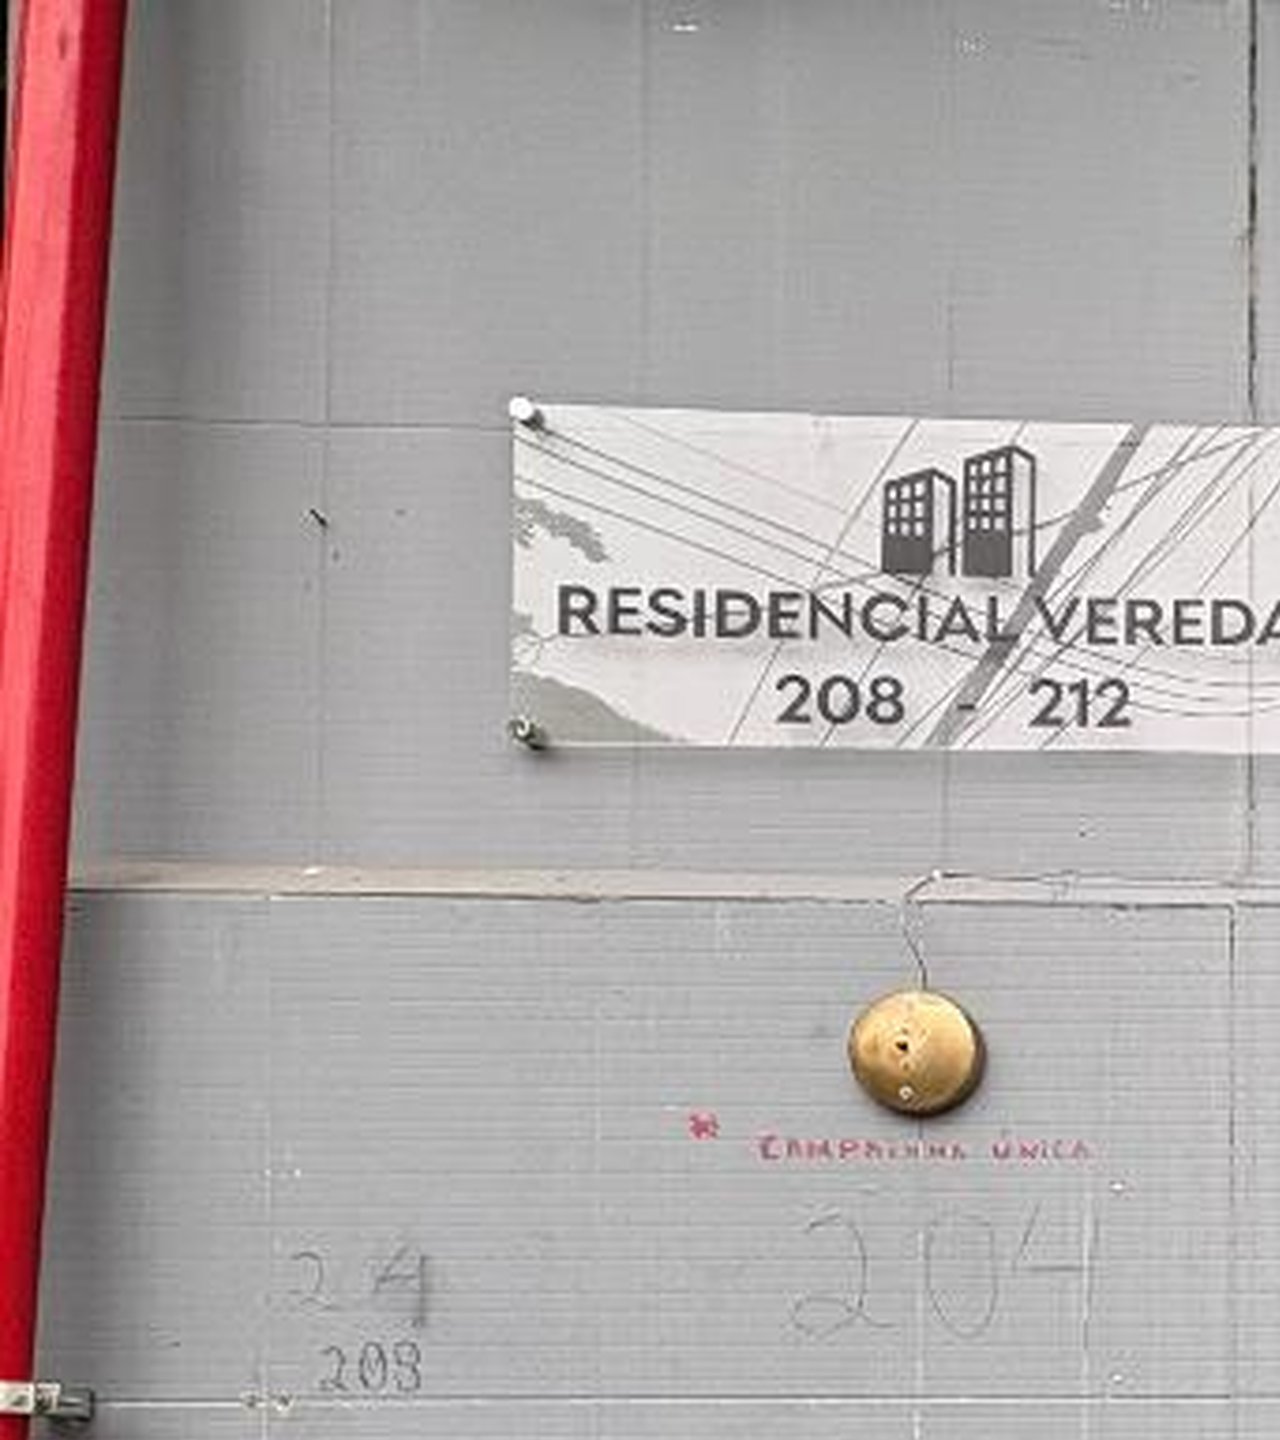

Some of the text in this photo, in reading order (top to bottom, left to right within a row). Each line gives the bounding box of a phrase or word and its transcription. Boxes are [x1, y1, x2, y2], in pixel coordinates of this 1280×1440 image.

[556, 584, 1022, 645] RESIDENCIAL
[774, 673, 906, 726] 208
[1028, 677, 1132, 730] 212
